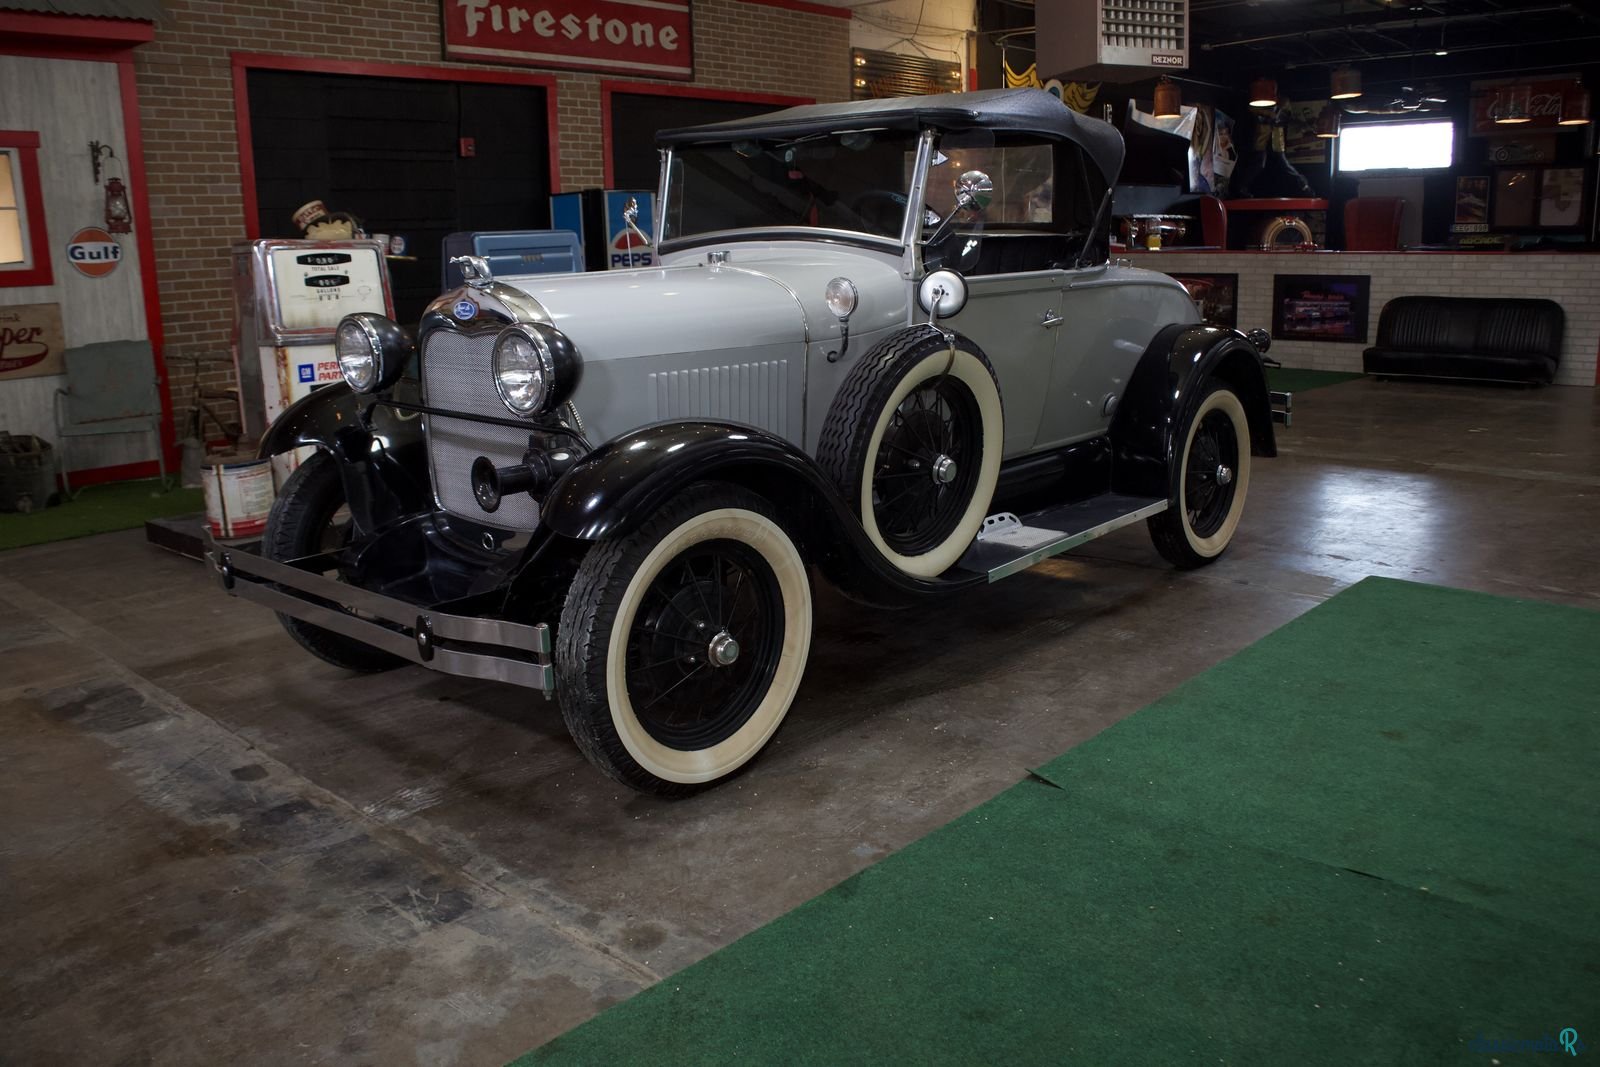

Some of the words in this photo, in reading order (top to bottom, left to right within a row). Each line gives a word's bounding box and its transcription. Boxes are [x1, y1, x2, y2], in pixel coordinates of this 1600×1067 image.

[457, 0, 679, 50] Firestone
[1152, 55, 1183, 65] REZNOR
[69, 245, 120, 261] Gulf
[611, 252, 653, 267] PEPS
[0, 327, 43, 357] per
[317, 361, 339, 371] PER
[318, 371, 342, 381] PART
